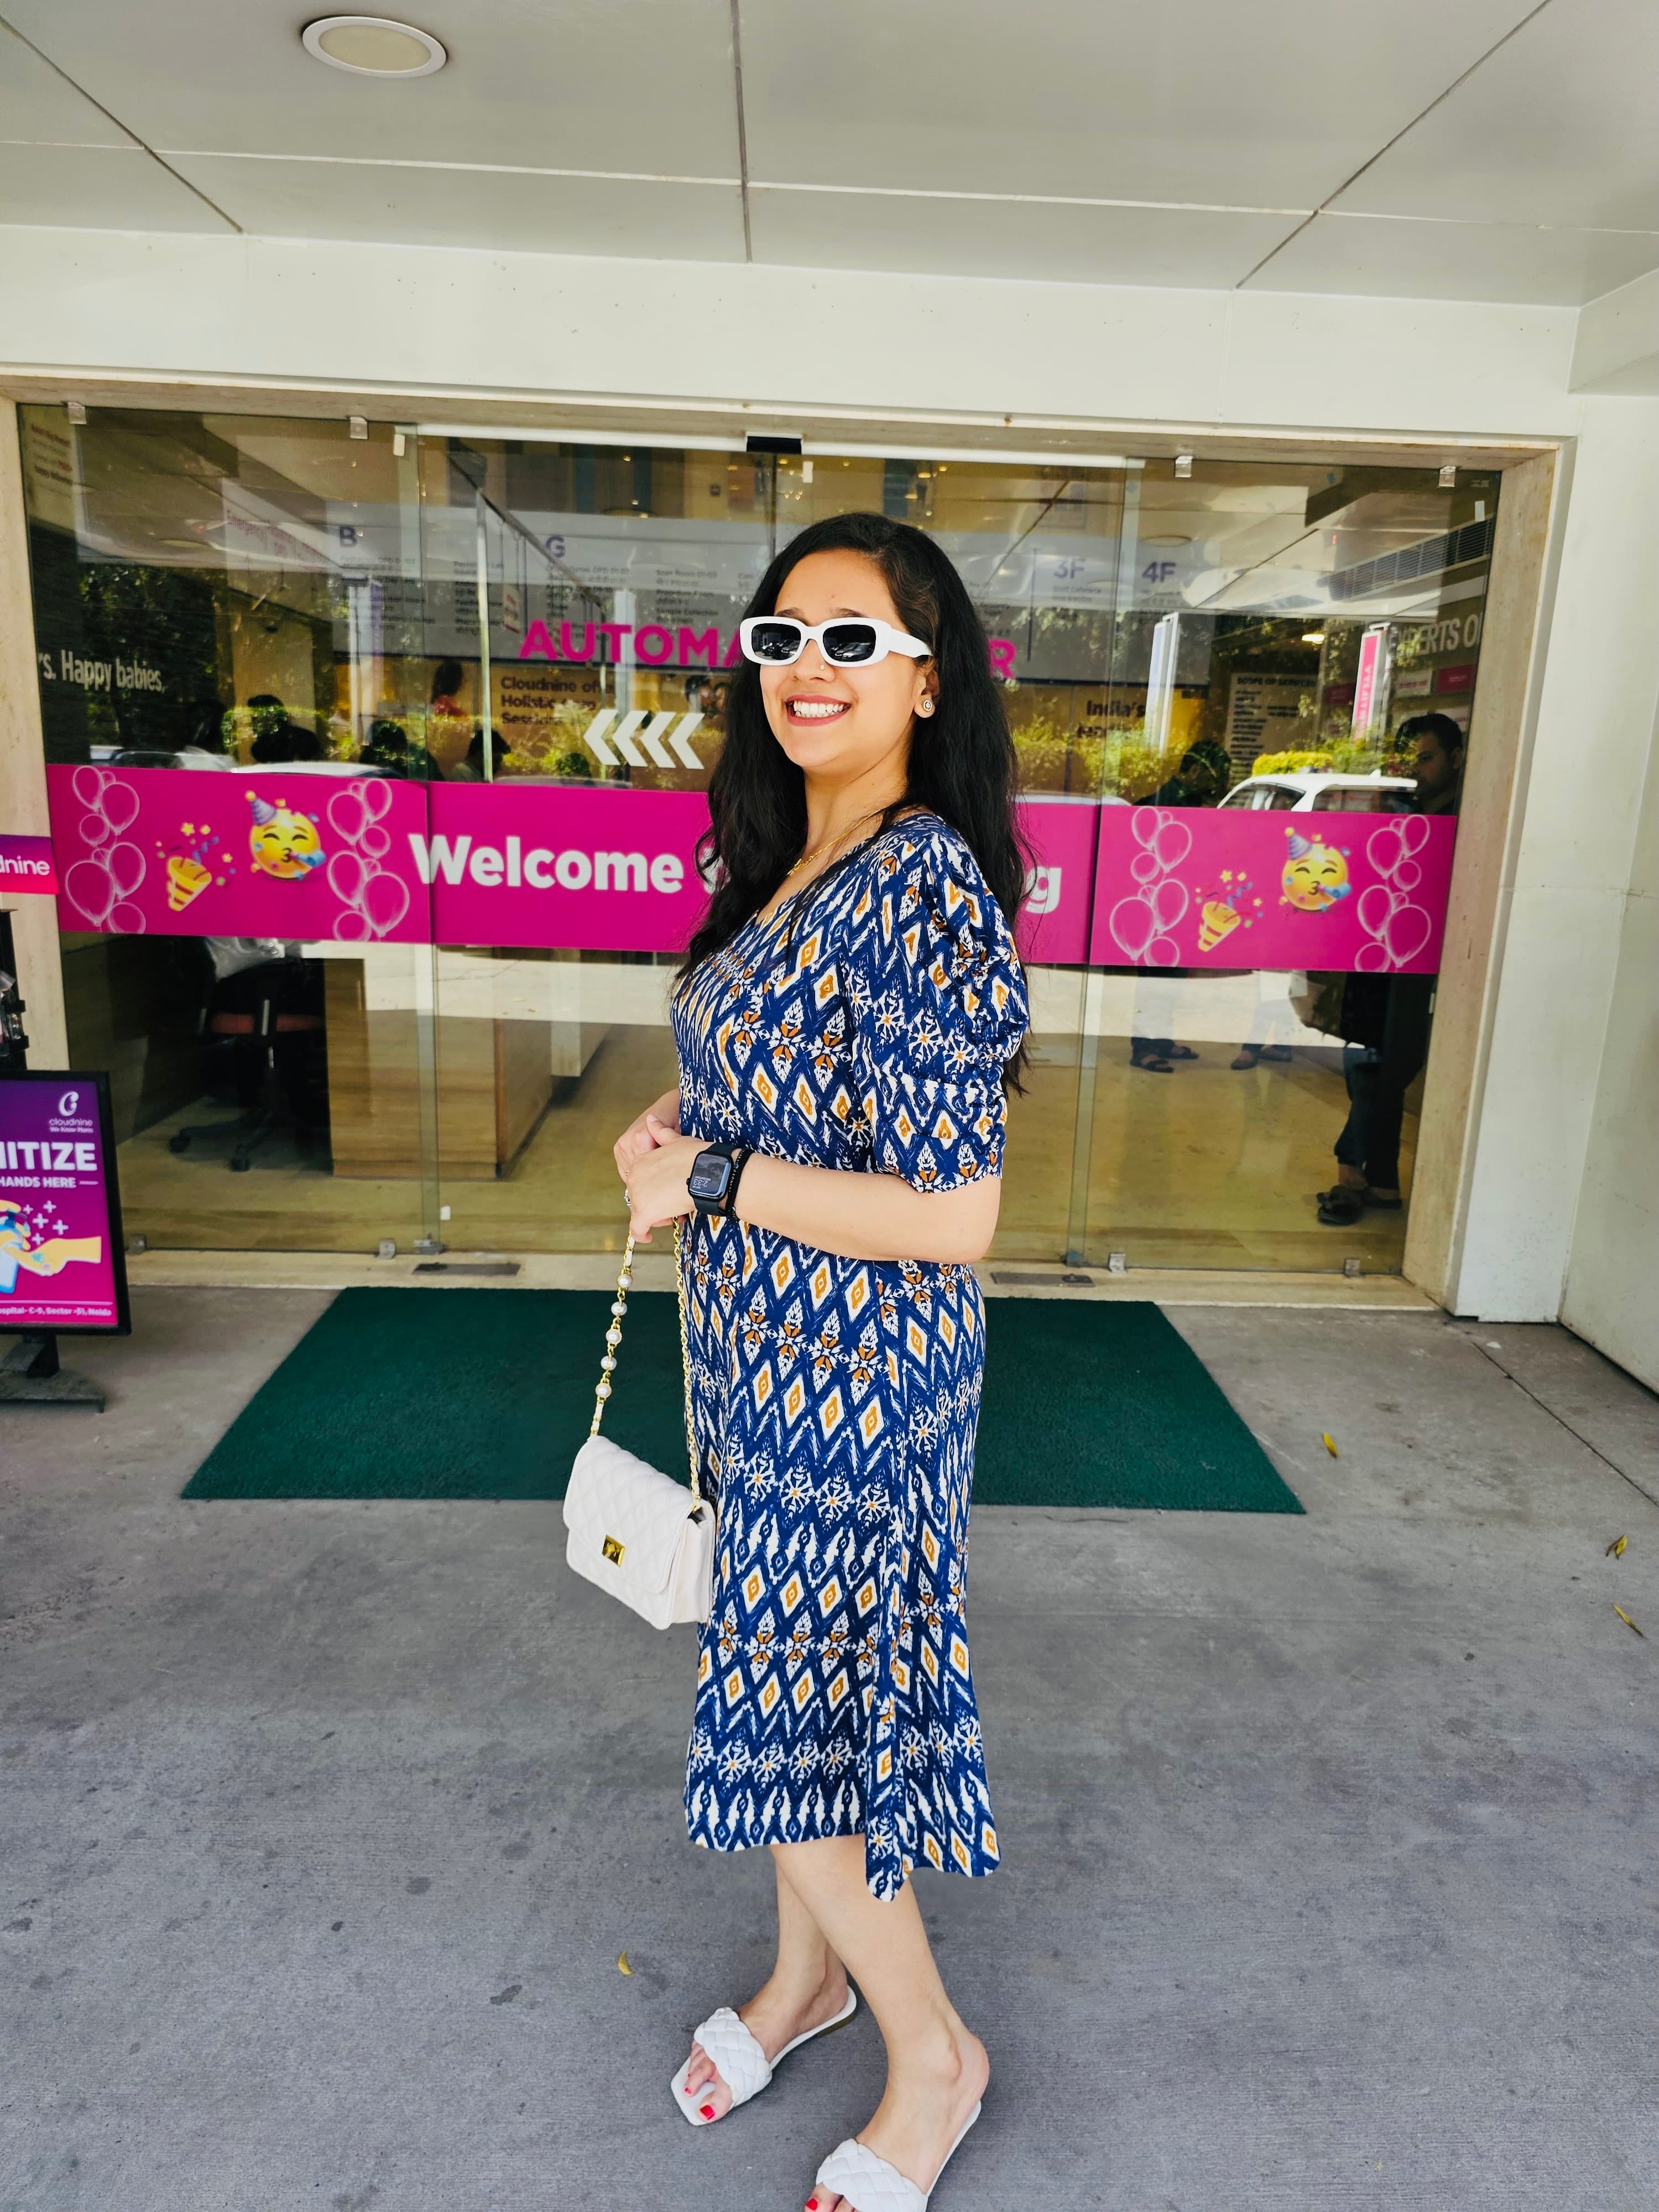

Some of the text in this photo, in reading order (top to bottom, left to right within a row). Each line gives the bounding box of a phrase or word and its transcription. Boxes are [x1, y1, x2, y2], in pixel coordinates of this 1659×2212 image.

[340, 526, 357, 547] B
[545, 535, 566, 558] G
[1141, 561, 1176, 583] 4F
[61, 649, 112, 692] Happy
[408, 833, 684, 894] Welcome
[49, 1118, 93, 1127] cloudnine
[43, 1177, 77, 1188] HERE
